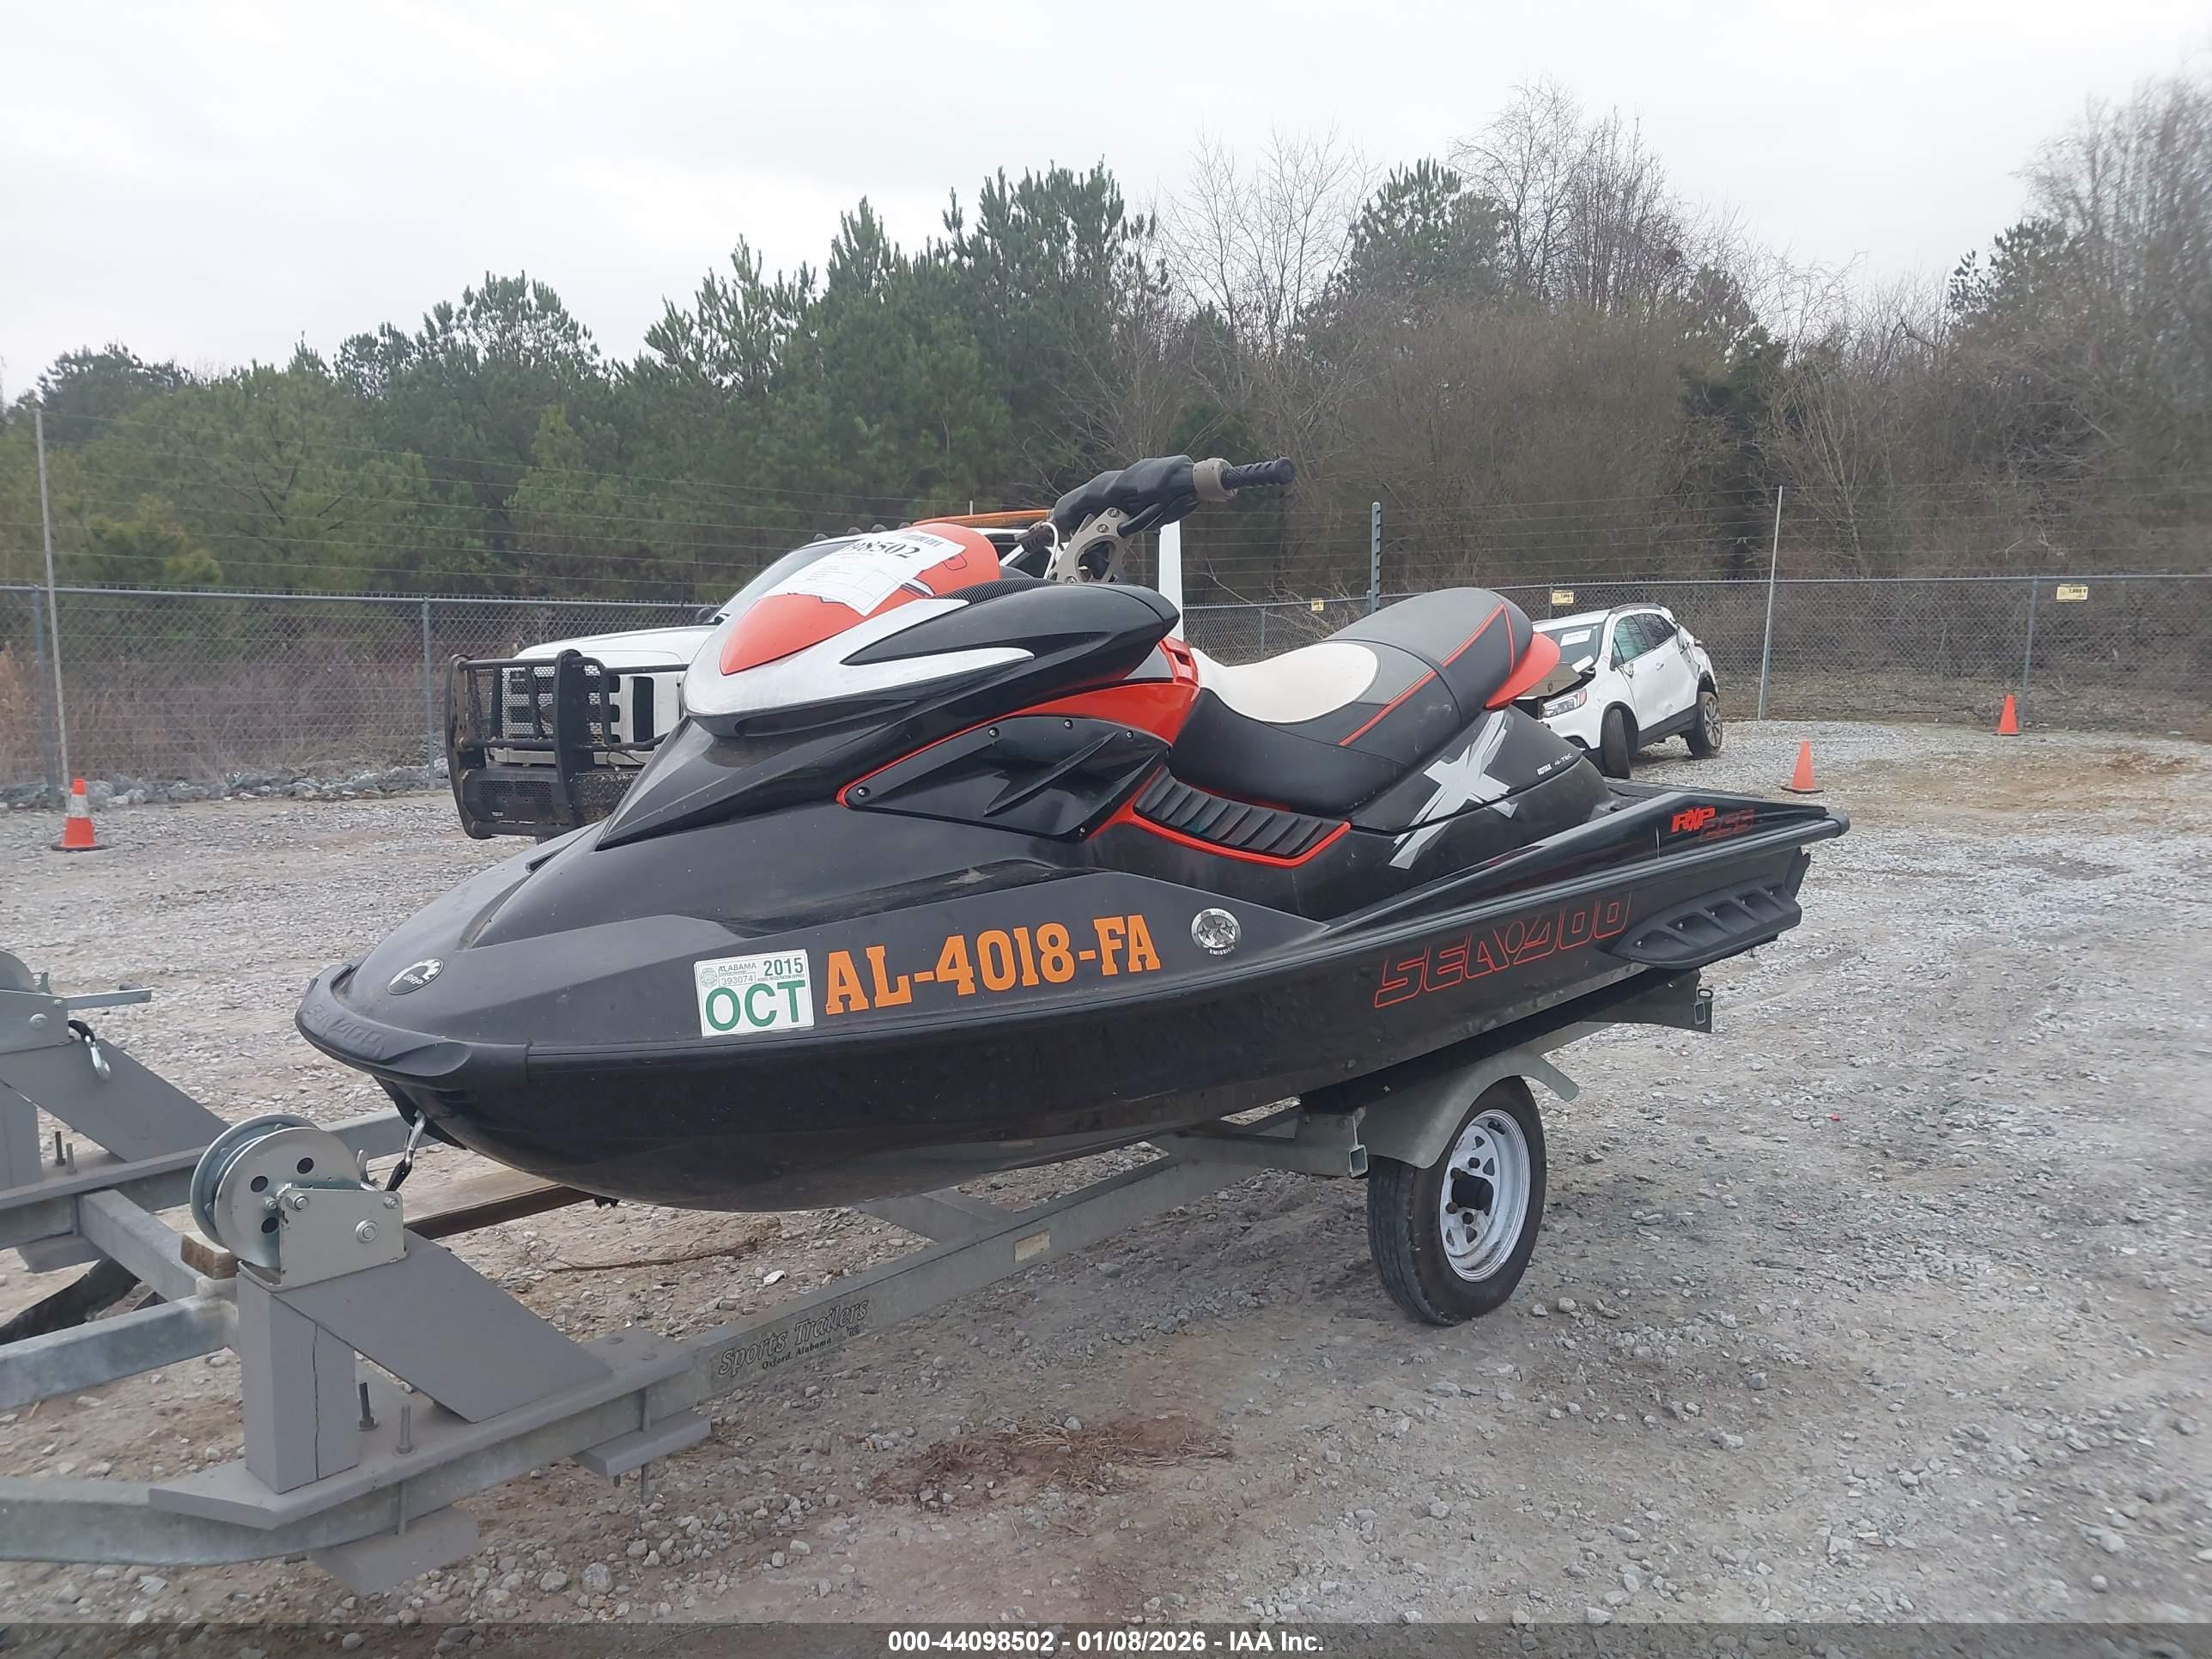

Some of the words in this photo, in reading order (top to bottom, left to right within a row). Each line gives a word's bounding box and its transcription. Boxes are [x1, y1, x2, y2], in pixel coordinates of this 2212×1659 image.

[1671, 805, 1716, 833] RXP
[718, 962, 757, 972] ALABAMA
[763, 957, 804, 976] 2015
[825, 915, 1161, 1014] AL-4018-FA
[403, 974, 424, 985] BRP
[721, 975, 754, 986] 393074
[705, 980, 806, 1031] OCT
[719, 1331, 788, 1377] Sports
[794, 1299, 870, 1345] Trailers
[796, 1337, 832, 1358] Alabama
